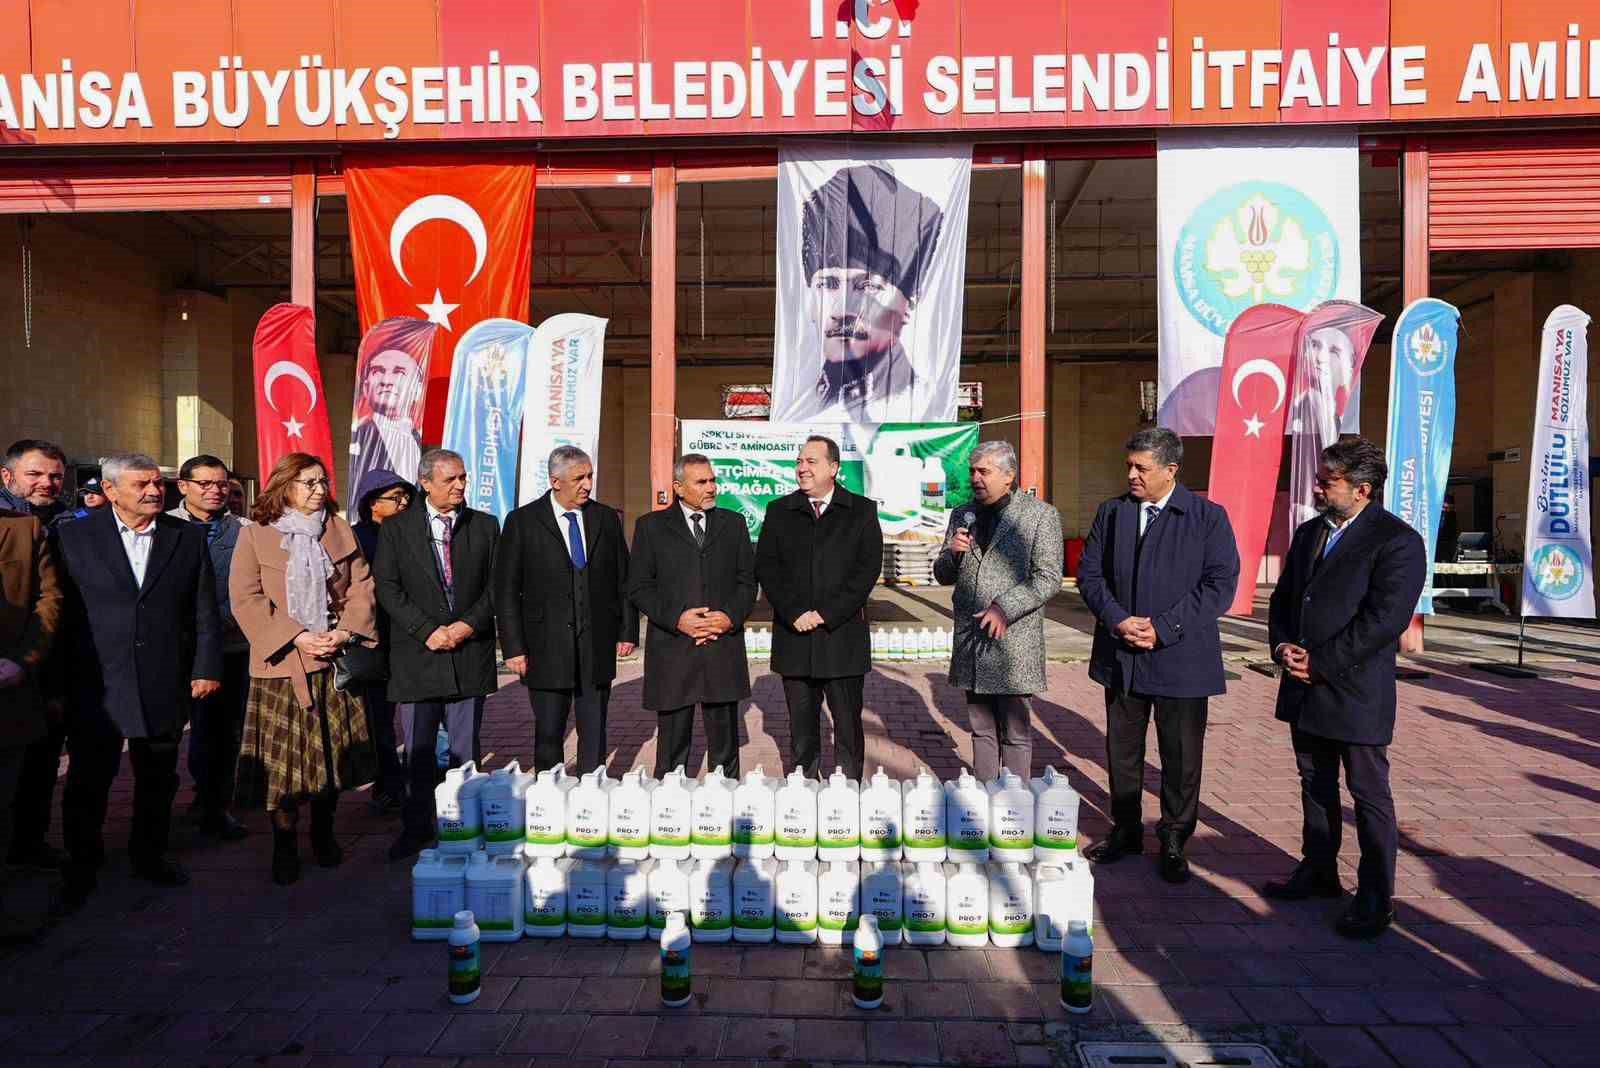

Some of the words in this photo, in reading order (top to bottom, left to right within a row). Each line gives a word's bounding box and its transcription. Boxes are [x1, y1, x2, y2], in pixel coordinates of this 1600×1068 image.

[172, 50, 543, 139] BÜYÜKŞEHİR
[563, 44, 904, 121] BELEDİYESİ
[923, 37, 1169, 116] SELENDİ
[1191, 32, 1427, 109] İTFAİYE
[1550, 433, 1570, 533] DUTLULU
[1047, 829, 1070, 837] PRO-7
[1004, 913, 1027, 921] PRO-7
